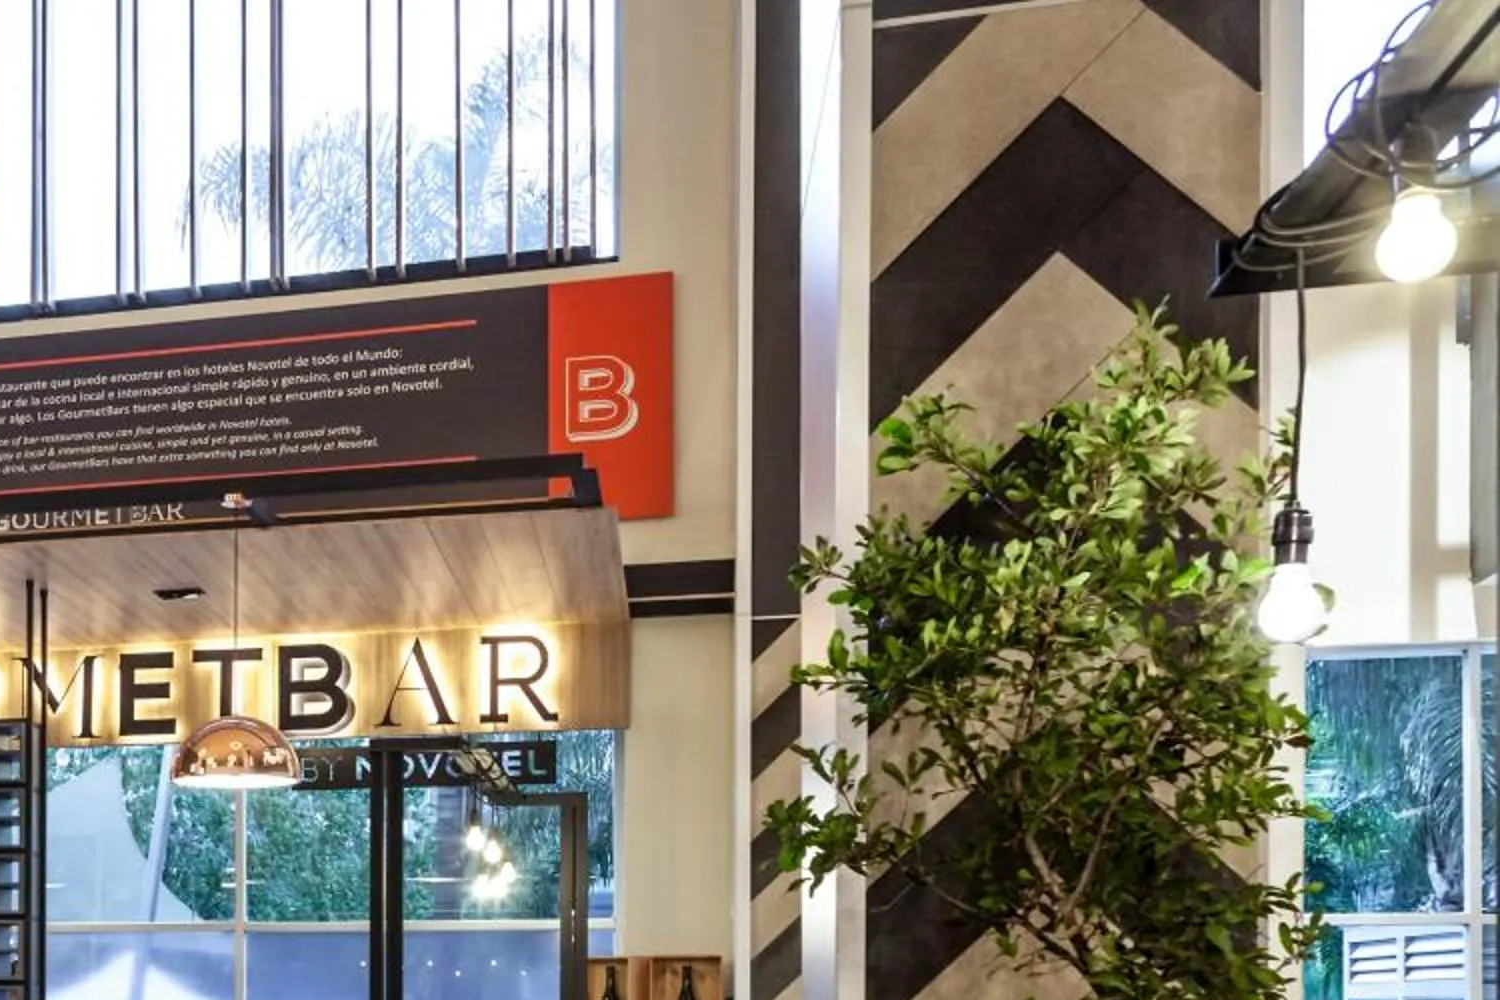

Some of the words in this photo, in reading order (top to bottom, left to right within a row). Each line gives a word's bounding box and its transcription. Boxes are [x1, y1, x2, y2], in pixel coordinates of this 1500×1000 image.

[15, 396, 29, 408] de
[31, 395, 41, 406] la
[43, 392, 77, 405] cocina
[80, 389, 105, 402] local
[107, 391, 115, 400] e
[117, 382, 190, 399] internacional
[192, 380, 229, 394] simple
[232, 376, 269, 391] rápido
[271, 377, 278, 389] y
[280, 372, 330, 388] genuino,
[333, 371, 348, 381] en
[352, 369, 367, 379] un
[369, 362, 427, 378] ambiente
[429, 357, 475, 373] cordial,
[50, 378, 71, 391] que
[73, 372, 107, 389] puede
[110, 368, 164, 383] encontrar
[167, 368, 181, 378] en
[183, 364, 201, 377] los
[203, 361, 245, 375] hoteles
[247, 356, 292, 371] Novotel
[294, 355, 309, 367] de
[311, 352, 339, 366] todo
[342, 350, 354, 363] el
[37, 410, 55, 422] Los
[57, 405, 130, 420] GourmetBars
[132, 402, 168, 414] tienen
[171, 399, 194, 412] algo
[197, 394, 244, 410] especial
[245, 395, 267, 407] que
[269, 393, 283, 403] se
[285, 386, 344, 401] encuentra
[346, 384, 372, 396] solo
[374, 384, 391, 394] en
[392, 378, 443, 392] Novotel.
[565, 355, 639, 442] B
[301, 757, 343, 783] BY
